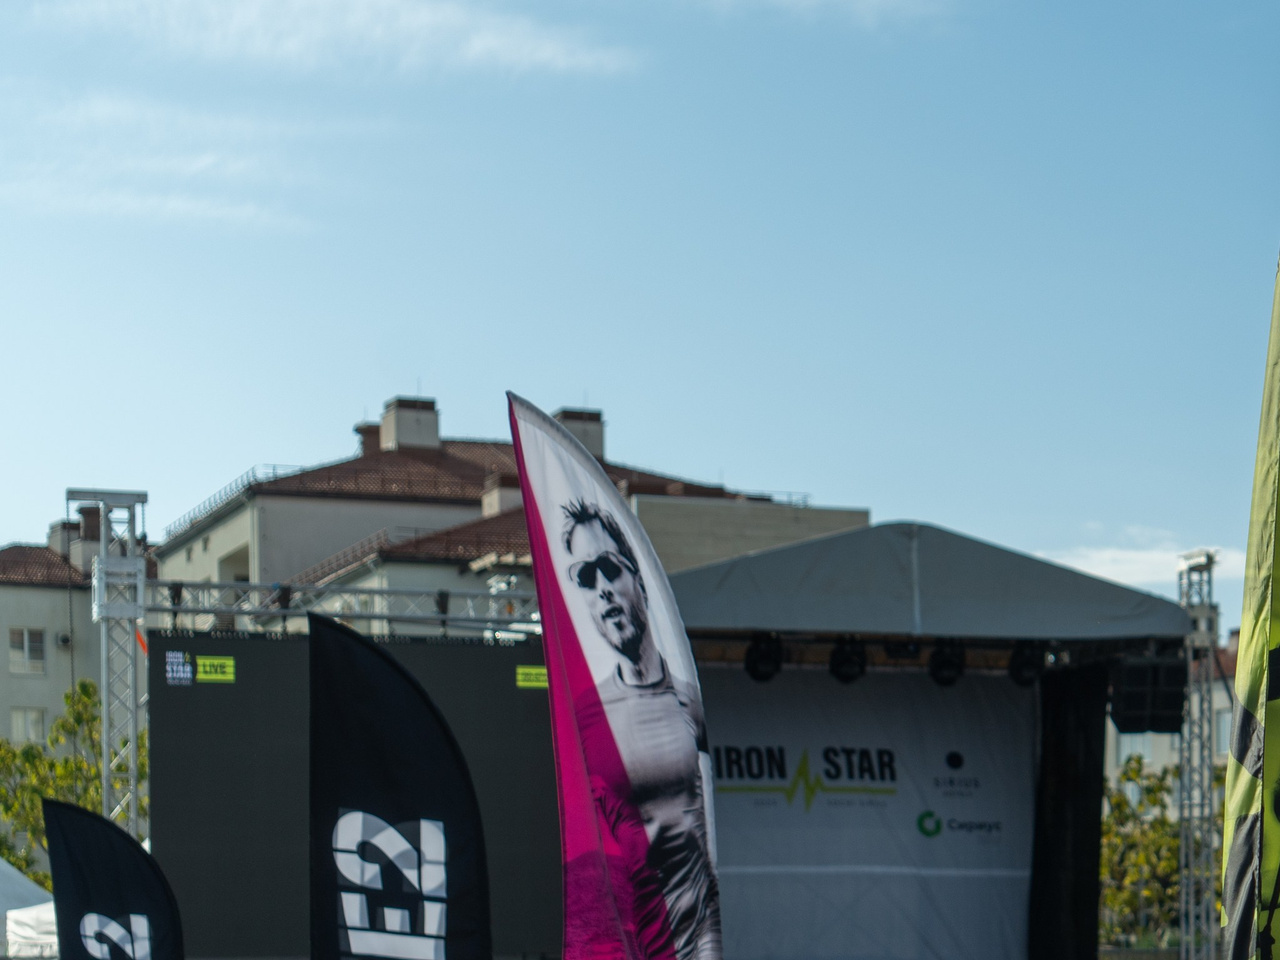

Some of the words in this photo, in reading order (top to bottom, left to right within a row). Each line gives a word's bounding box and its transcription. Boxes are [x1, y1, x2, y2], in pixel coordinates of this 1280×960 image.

[202, 661, 227, 675] LIVE
[714, 745, 787, 780] IRON
[823, 747, 897, 783] STAR
